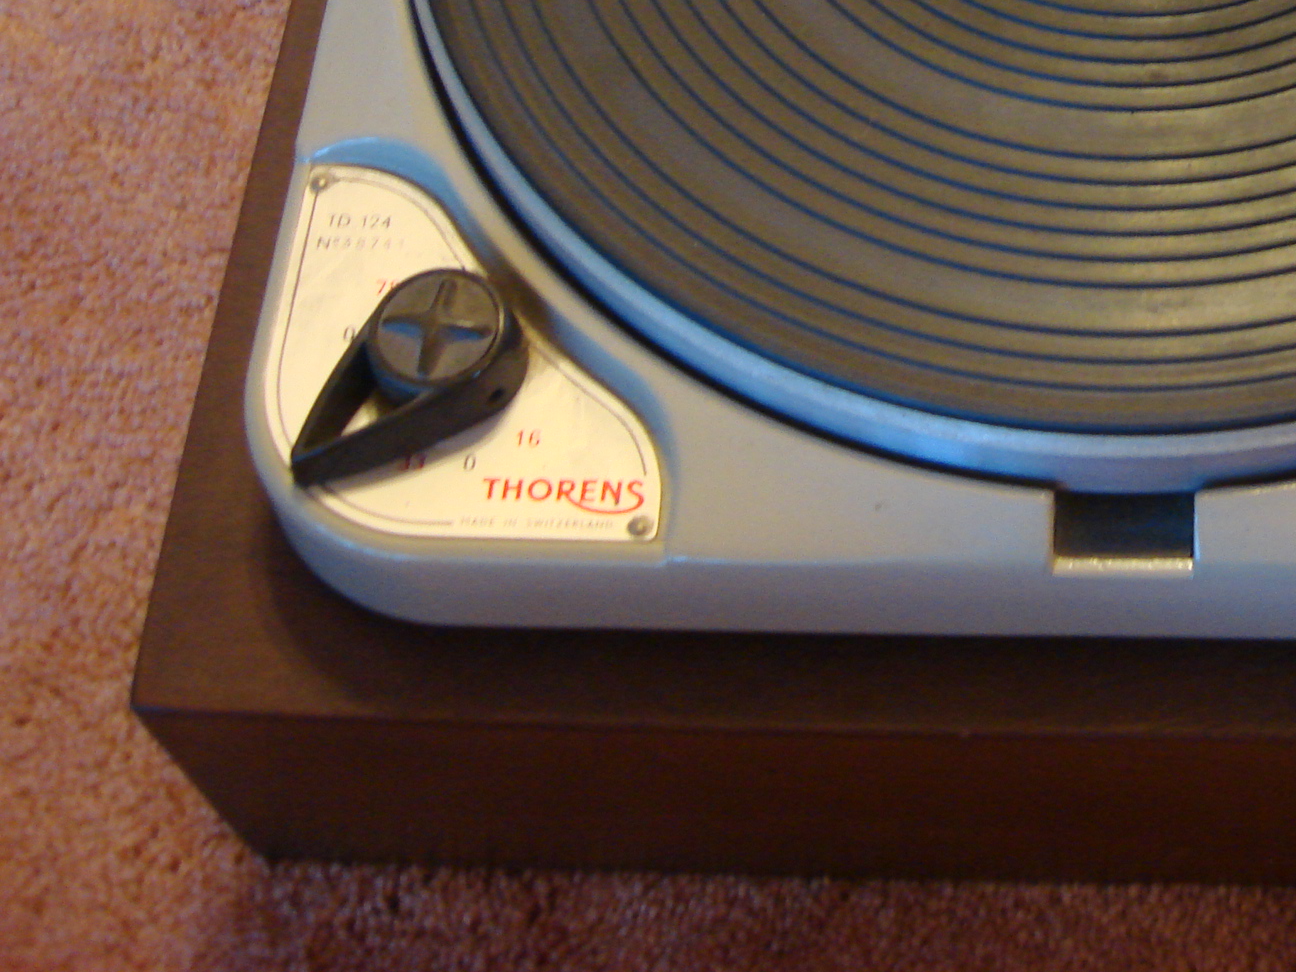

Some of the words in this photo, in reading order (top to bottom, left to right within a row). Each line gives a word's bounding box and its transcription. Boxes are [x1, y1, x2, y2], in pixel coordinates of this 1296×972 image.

[329, 213, 351, 228] TD
[362, 213, 391, 229] 124
[516, 429, 541, 448] 16
[463, 454, 477, 471] 0
[483, 477, 645, 515] THORENS
